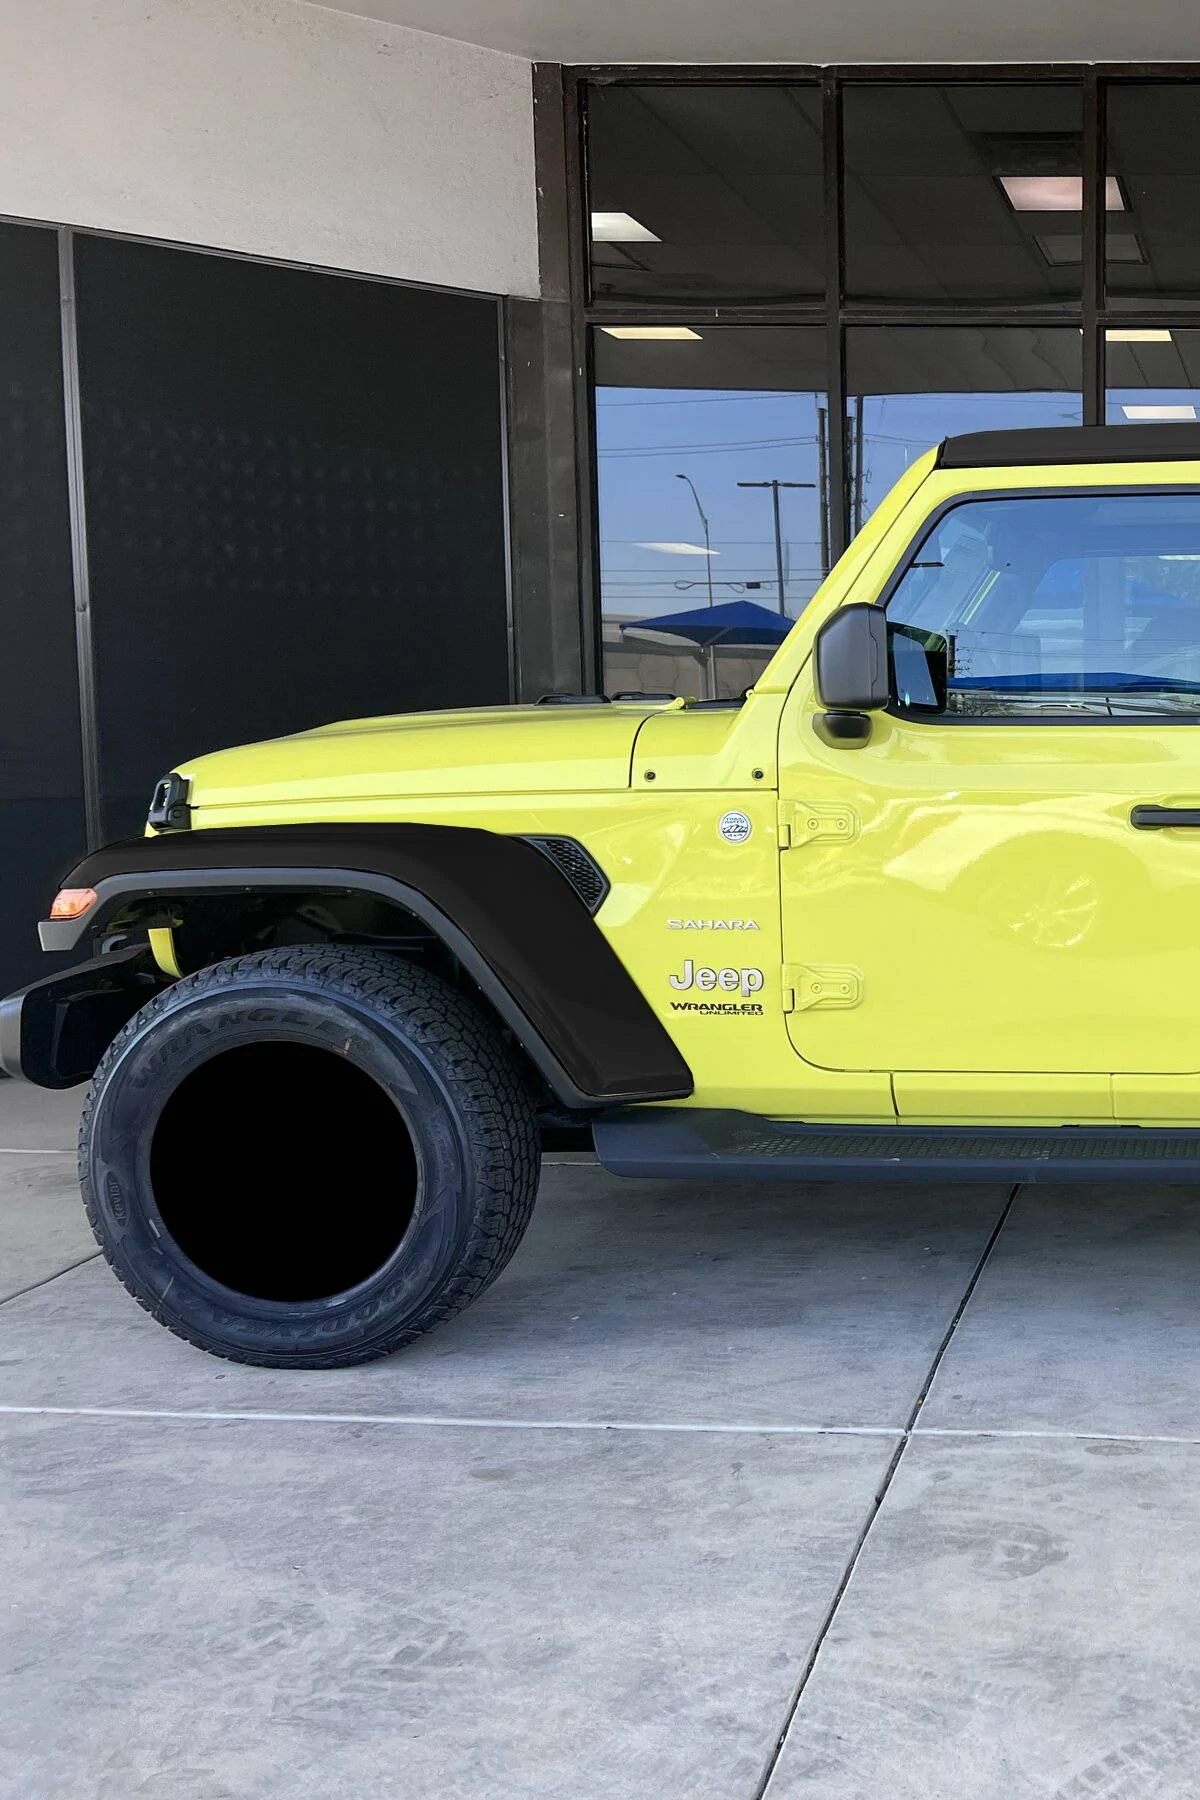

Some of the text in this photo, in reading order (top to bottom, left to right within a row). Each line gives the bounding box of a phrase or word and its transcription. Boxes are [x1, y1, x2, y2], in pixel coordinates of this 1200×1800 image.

[668, 918, 760, 930] SAHARA
[669, 959, 763, 997] Jeep
[670, 1002, 763, 1011] WRANGLER
[109, 1179, 127, 1221] Kevlar
